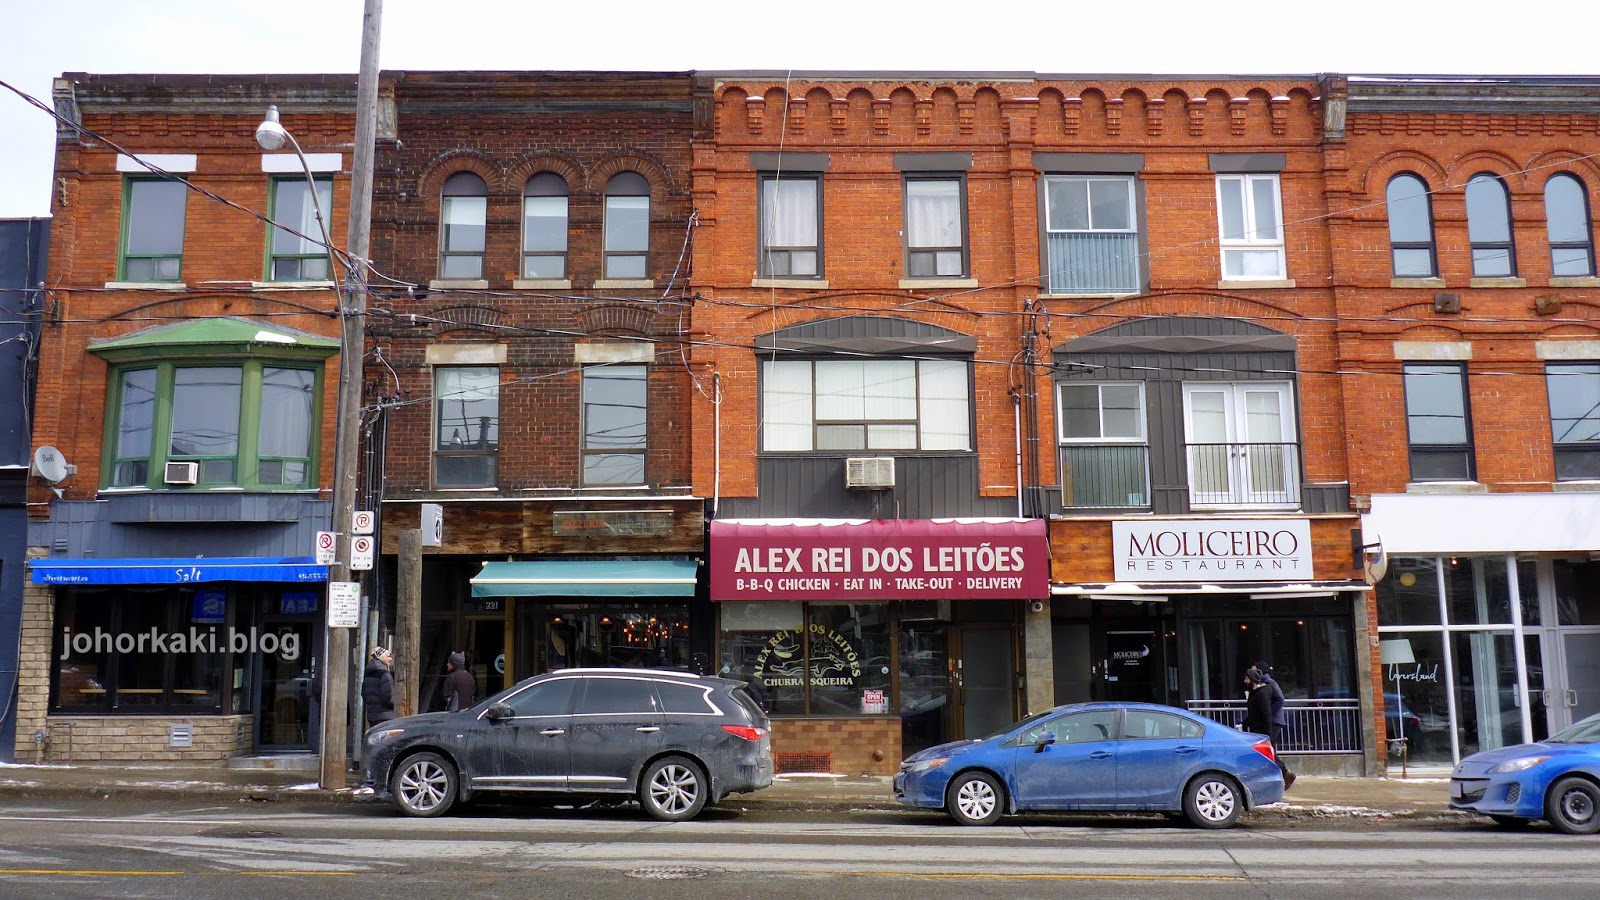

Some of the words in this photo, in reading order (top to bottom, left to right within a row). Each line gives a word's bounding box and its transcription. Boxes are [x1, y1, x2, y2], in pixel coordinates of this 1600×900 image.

[42, 454, 55, 463] Bell
[1129, 531, 1298, 557] MOLICEIRO
[734, 548, 804, 573] ALEX
[811, 548, 851, 573] REI
[862, 547, 914, 572] DOS
[923, 542, 1025, 572] LEITÕES
[1127, 559, 1299, 570] RESTAURANT
[175, 567, 203, 582] Salt
[736, 578, 774, 592] B-B-Q
[777, 578, 831, 591] CHICKEN
[843, 578, 865, 590] EAT
[869, 578, 883, 590] IN
[895, 577, 954, 590] TAKE-OUT
[966, 577, 1023, 590] DELIVERY
[754, 646, 772, 679] ALEX
[769, 629, 789, 647] REI
[827, 629, 861, 678] LEITÕES
